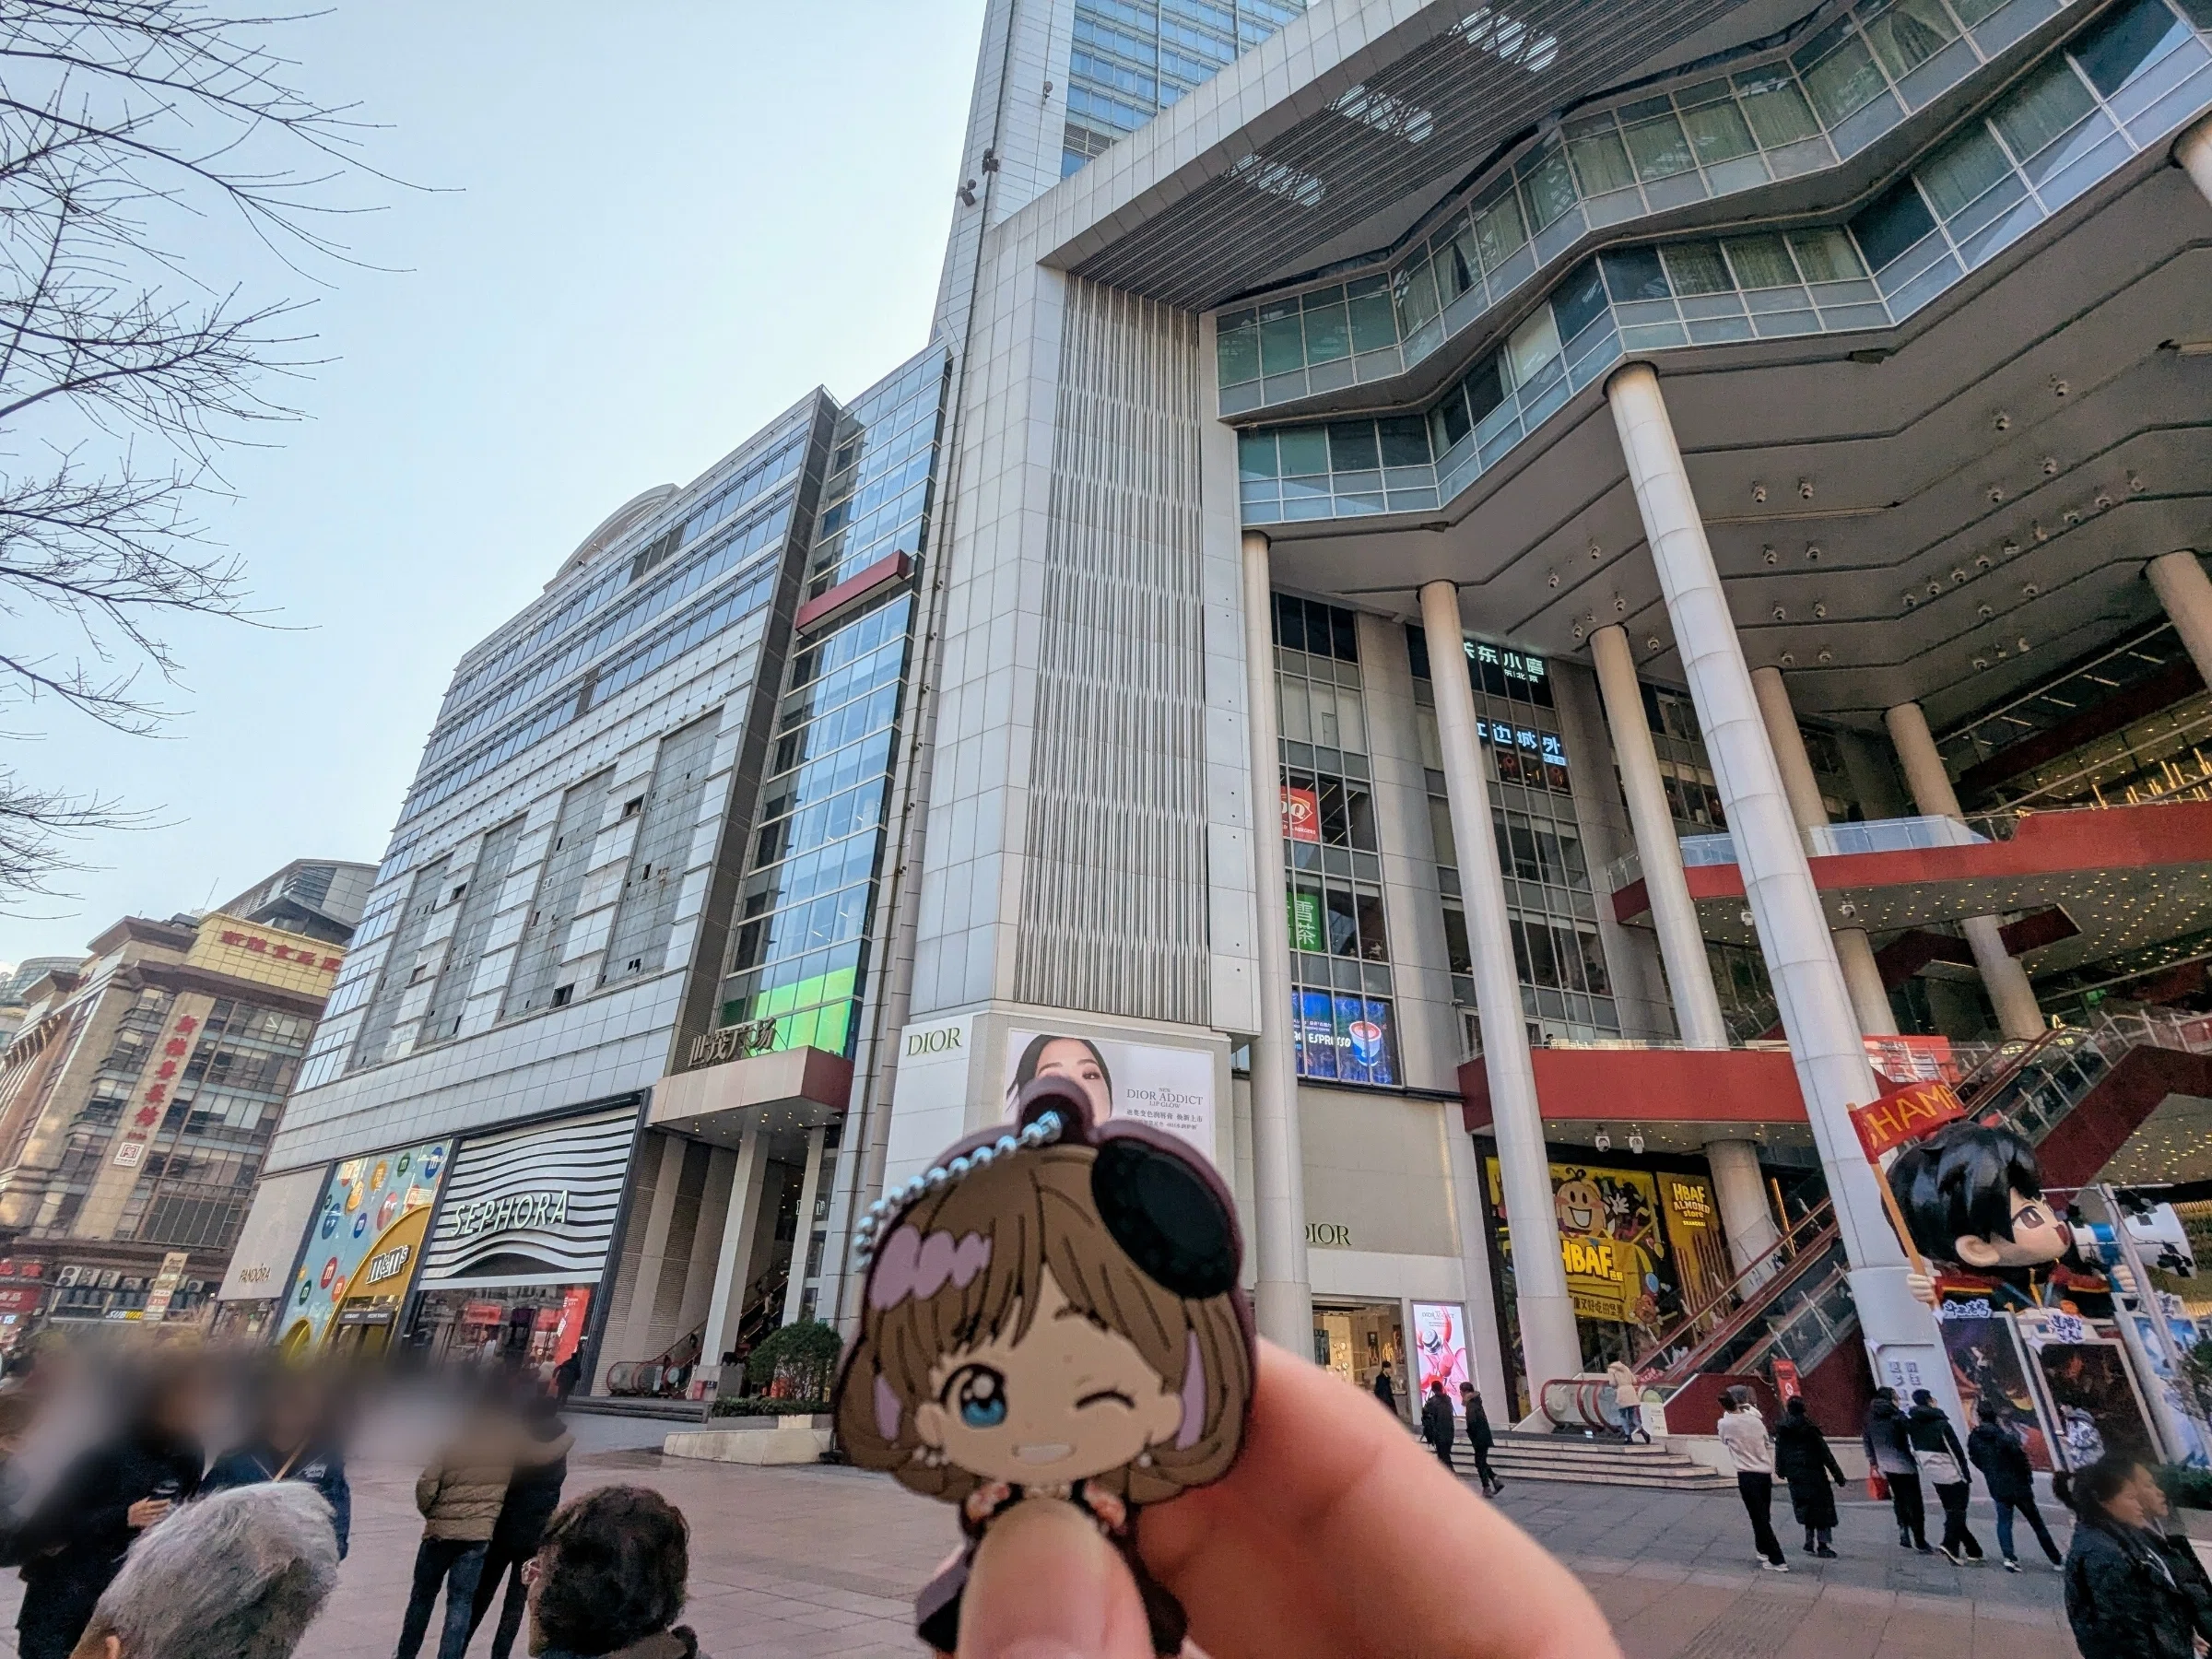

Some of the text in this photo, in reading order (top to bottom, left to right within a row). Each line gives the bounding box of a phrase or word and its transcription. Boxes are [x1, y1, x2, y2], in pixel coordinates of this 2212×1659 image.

[906, 1027, 962, 1056] DIOR
[1127, 1089, 1204, 1106] DIOR ADDICT
[1672, 1182, 1705, 1204] HBAF
[450, 1189, 570, 1238] SEPHORA
[1673, 1200, 1711, 1215] ALMOND
[1306, 1223, 1352, 1246] IOR
[105, 1310, 144, 1320] SUBWA
